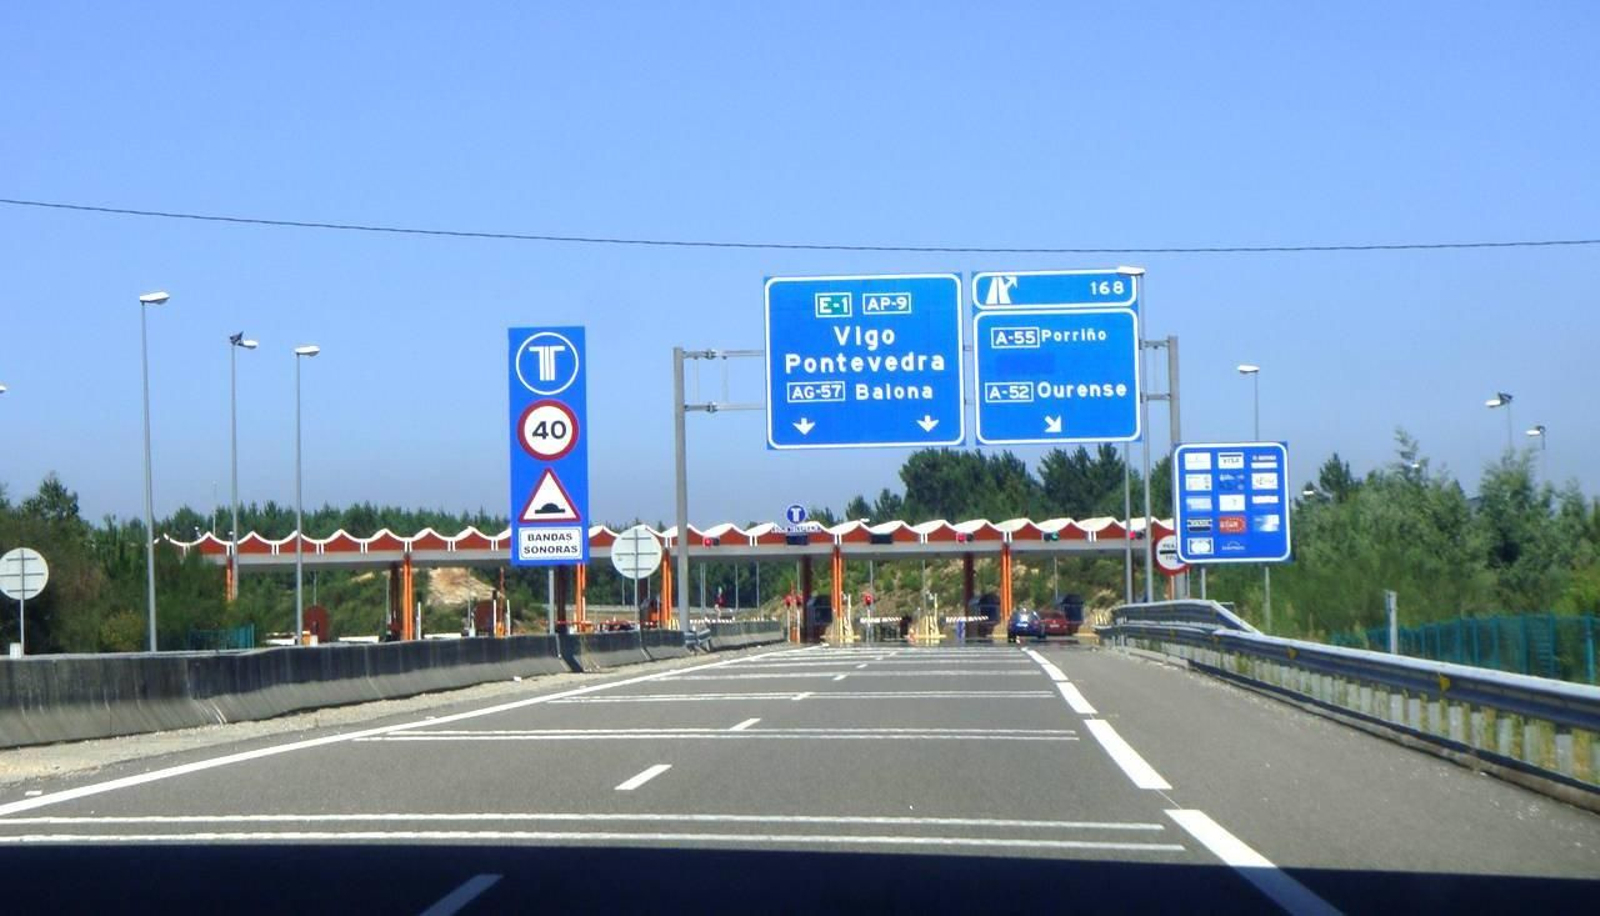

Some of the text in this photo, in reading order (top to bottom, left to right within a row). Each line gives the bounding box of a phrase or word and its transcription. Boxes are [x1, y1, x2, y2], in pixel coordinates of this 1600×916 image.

[1090, 281, 1125, 296] 168
[819, 296, 908, 313] E-1 AP-9
[834, 325, 896, 351] Vigo
[995, 328, 1107, 345] A-55 Porriño
[785, 351, 945, 374] Pontevedra
[791, 383, 933, 400] AG-57 Baiona
[989, 381, 1128, 399] A-52 Ourense
[532, 420, 567, 440] 40
[527, 533, 572, 541] BANDAS
[524, 545, 578, 554] SONORAS
